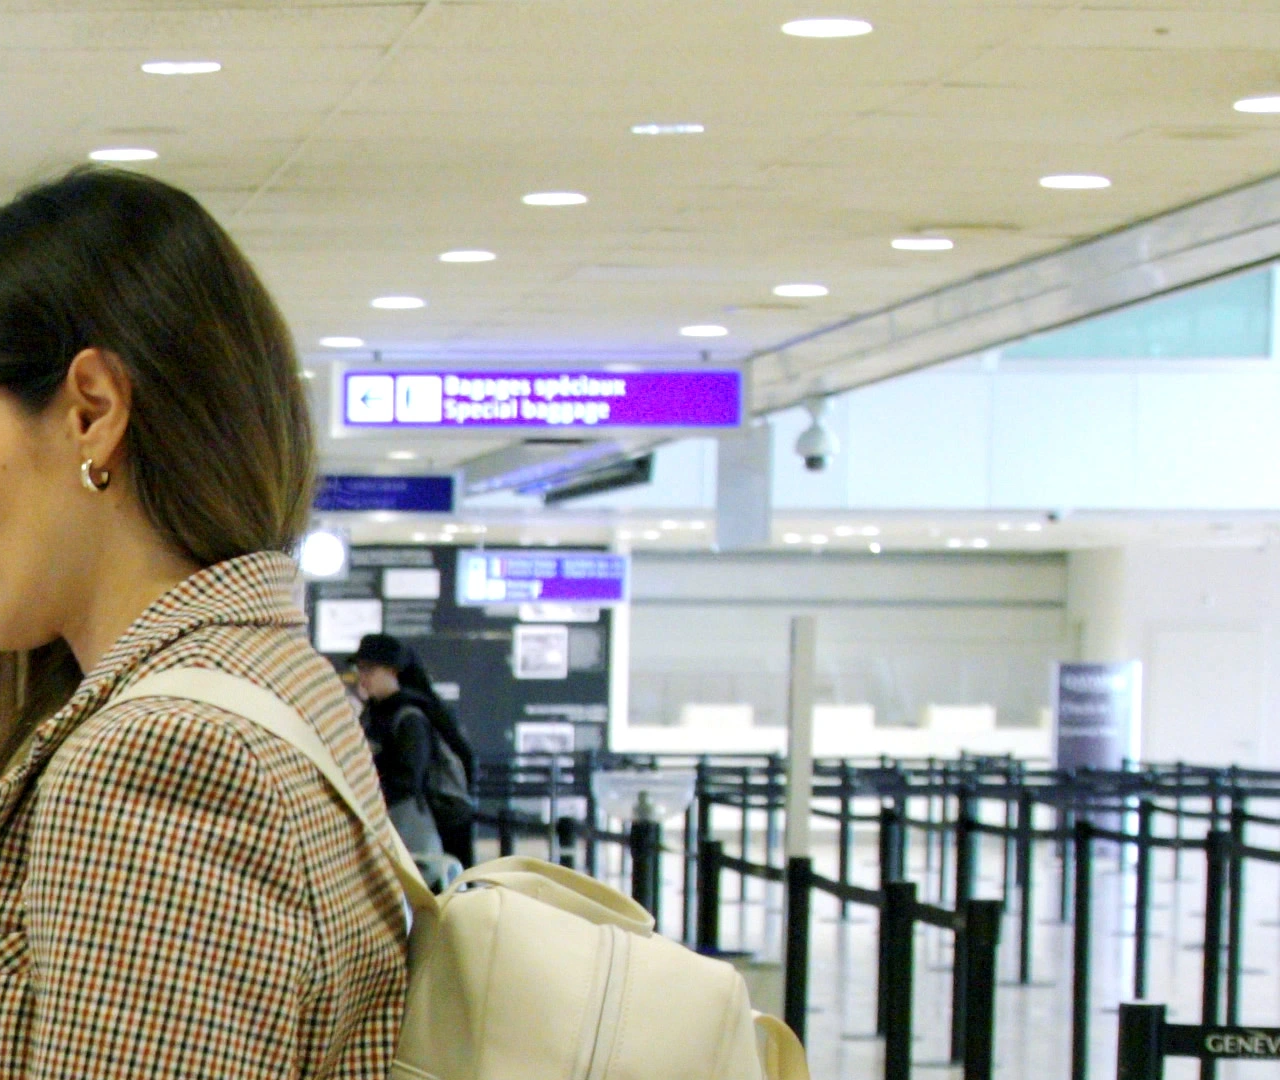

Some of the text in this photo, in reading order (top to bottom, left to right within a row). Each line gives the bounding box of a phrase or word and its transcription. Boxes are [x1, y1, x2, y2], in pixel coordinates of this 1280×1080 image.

[444, 374, 627, 401] Bagages spéciaux
[444, 397, 611, 425] Special baggage
